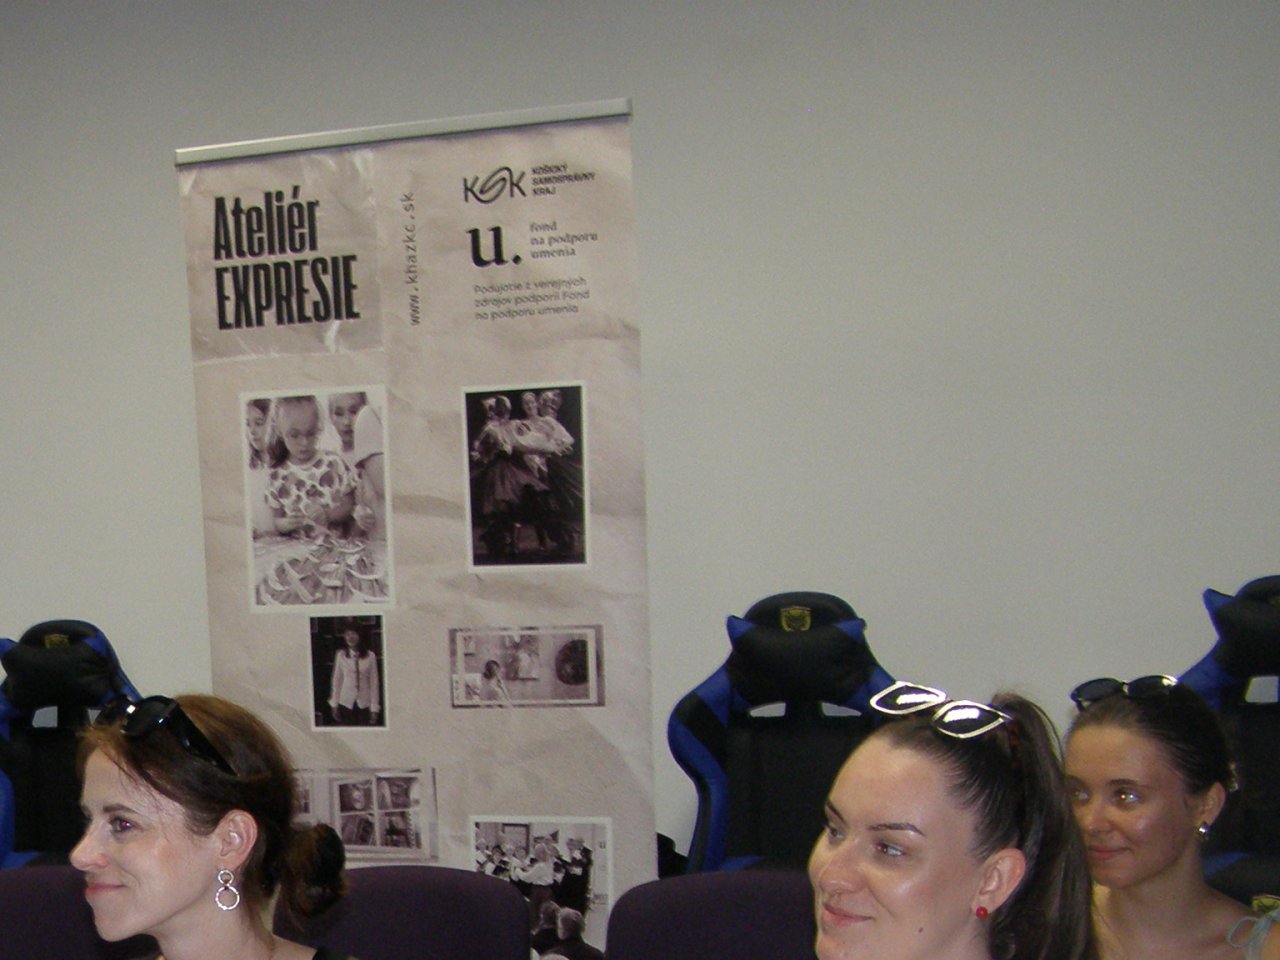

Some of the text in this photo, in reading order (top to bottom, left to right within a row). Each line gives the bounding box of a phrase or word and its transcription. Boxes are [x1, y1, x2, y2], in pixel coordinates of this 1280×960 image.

[214, 185, 320, 261] Ateliér
[401, 191, 422, 327] www.khazkc.sk
[531, 248, 576, 259] umenia
[548, 232, 598, 247] podporu
[215, 254, 361, 331] EXPRESIE
